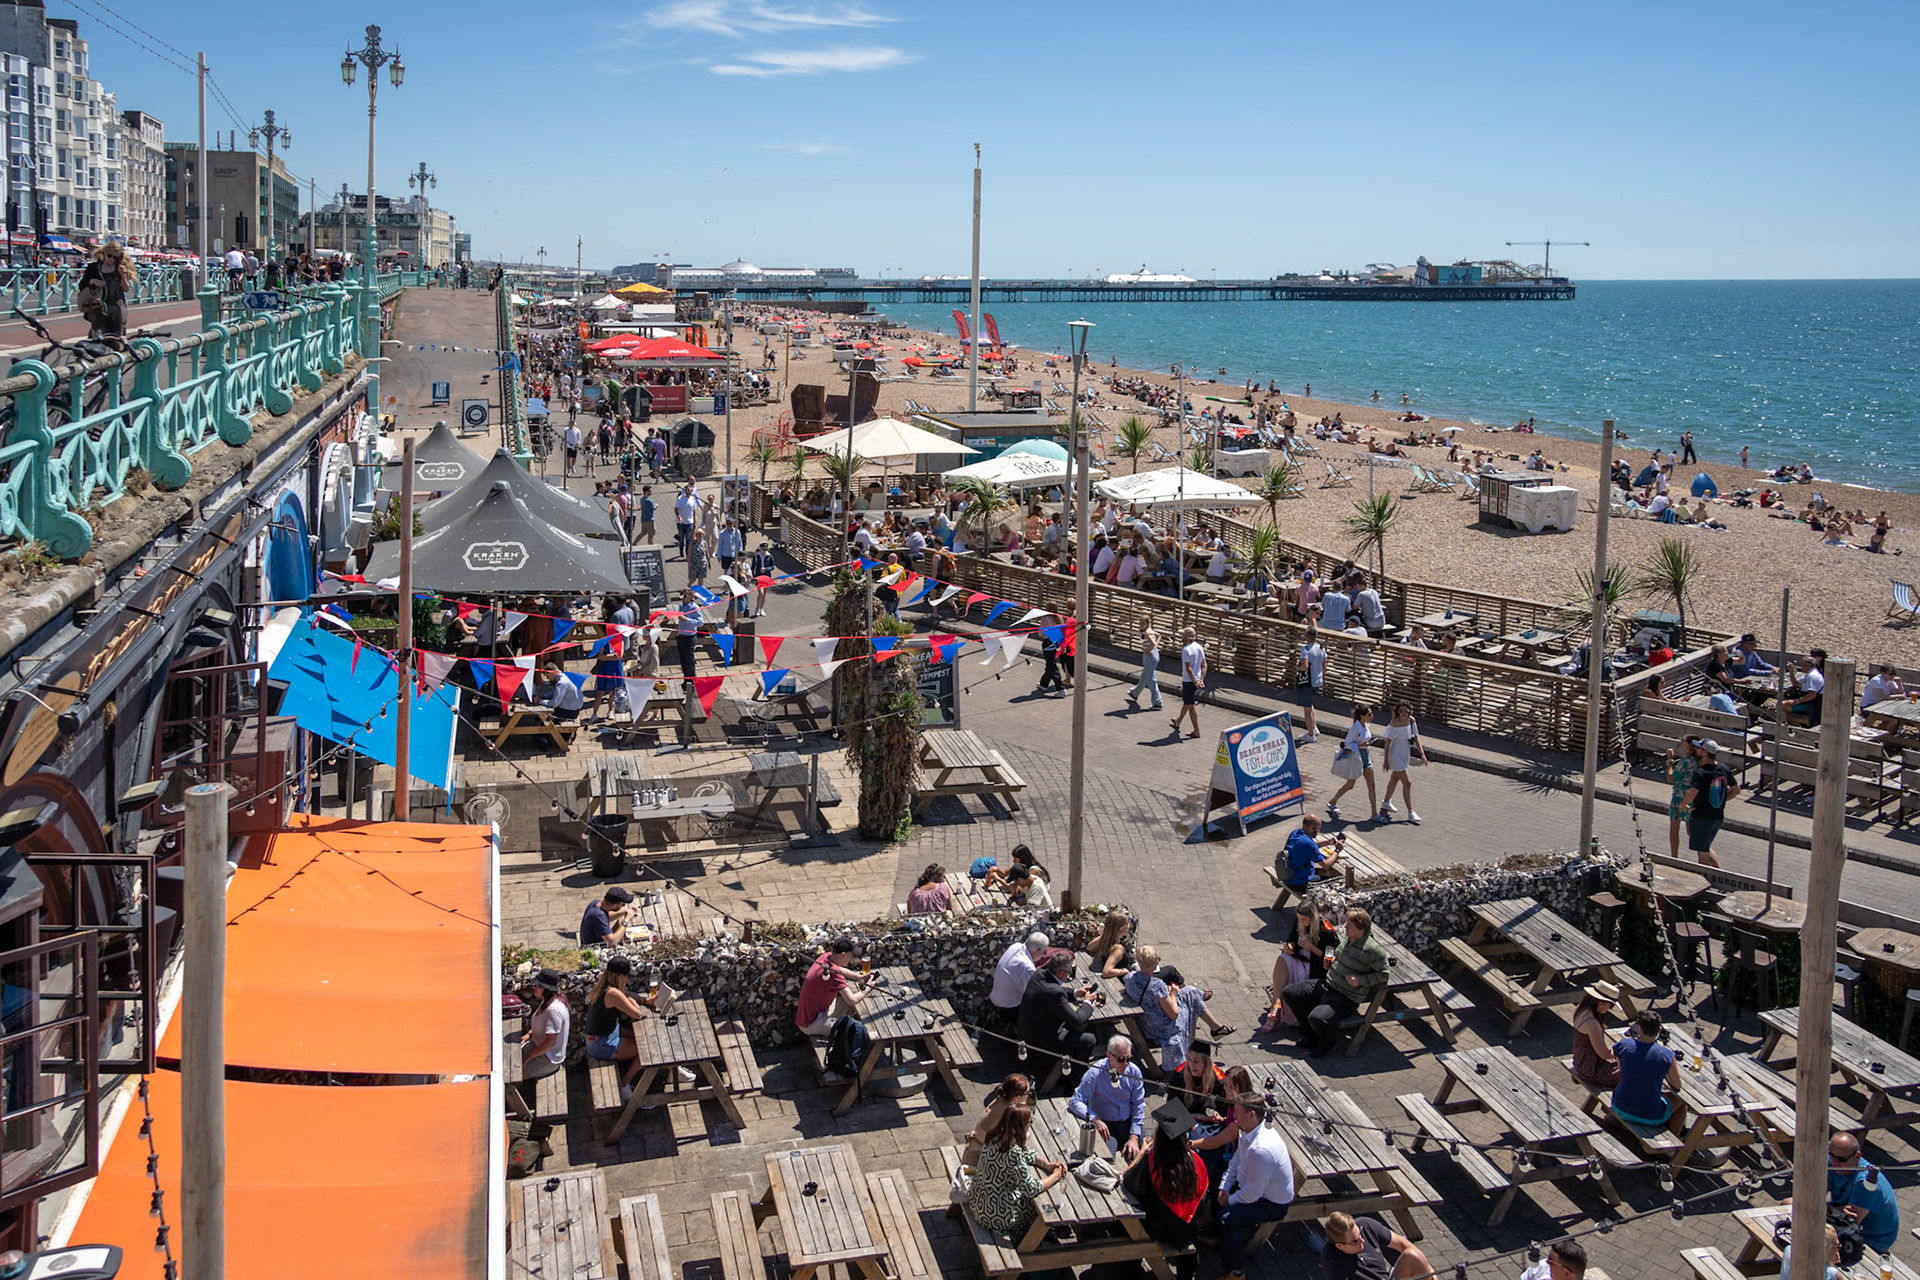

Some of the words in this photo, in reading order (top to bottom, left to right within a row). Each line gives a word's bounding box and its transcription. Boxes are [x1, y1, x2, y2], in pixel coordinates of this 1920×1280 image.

[434, 382, 447, 398] ART
[919, 667, 951, 681] TEMPEST
[1661, 706, 1692, 718] FORTUNE
[1705, 714, 1721, 723] WAR
[1239, 746, 1262, 759] BEACH
[1263, 738, 1285, 751] BREAK
[1246, 756, 1260, 770] FISH
[1261, 755, 1266, 764] &
[1266, 748, 1285, 764] CHIPS
[693, 821, 735, 831] TEMPEST
[1711, 875, 1756, 891] BURGERS
